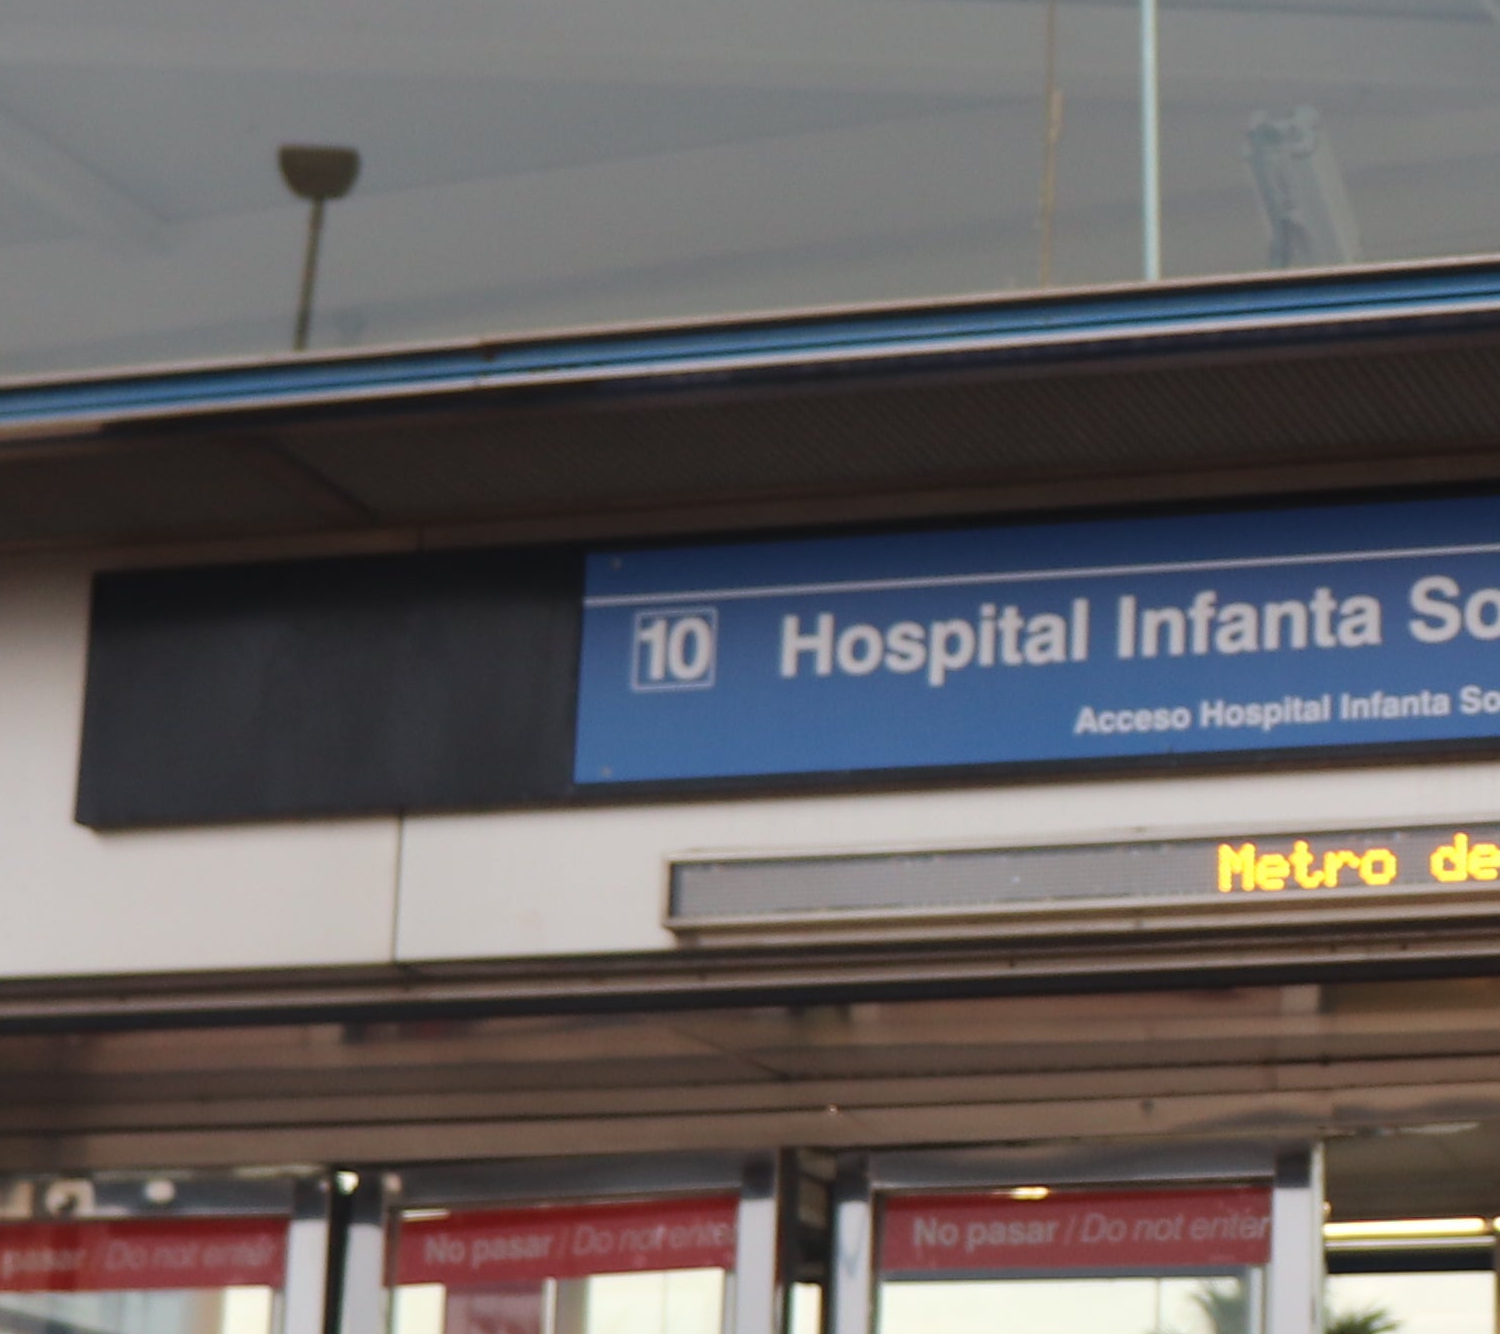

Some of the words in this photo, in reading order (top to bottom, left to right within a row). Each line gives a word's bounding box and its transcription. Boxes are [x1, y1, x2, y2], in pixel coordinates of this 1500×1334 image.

[638, 617, 714, 682] 10
[780, 598, 1090, 687] Hospital
[1116, 587, 1383, 659] Infanta
[1074, 704, 1191, 736] Acceso
[1201, 693, 1331, 731] Hospital
[1340, 688, 1451, 721] Infanta
[1217, 841, 1397, 892] Metro
[425, 1234, 465, 1264] No
[472, 1233, 554, 1270] pasar
[573, 1225, 615, 1256] Do
[913, 1217, 958, 1247] No
[965, 1217, 1061, 1254] pasar
[1081, 1213, 1128, 1244] Do
[1133, 1215, 1184, 1242] not
[1188, 1213, 1271, 1241] enter
